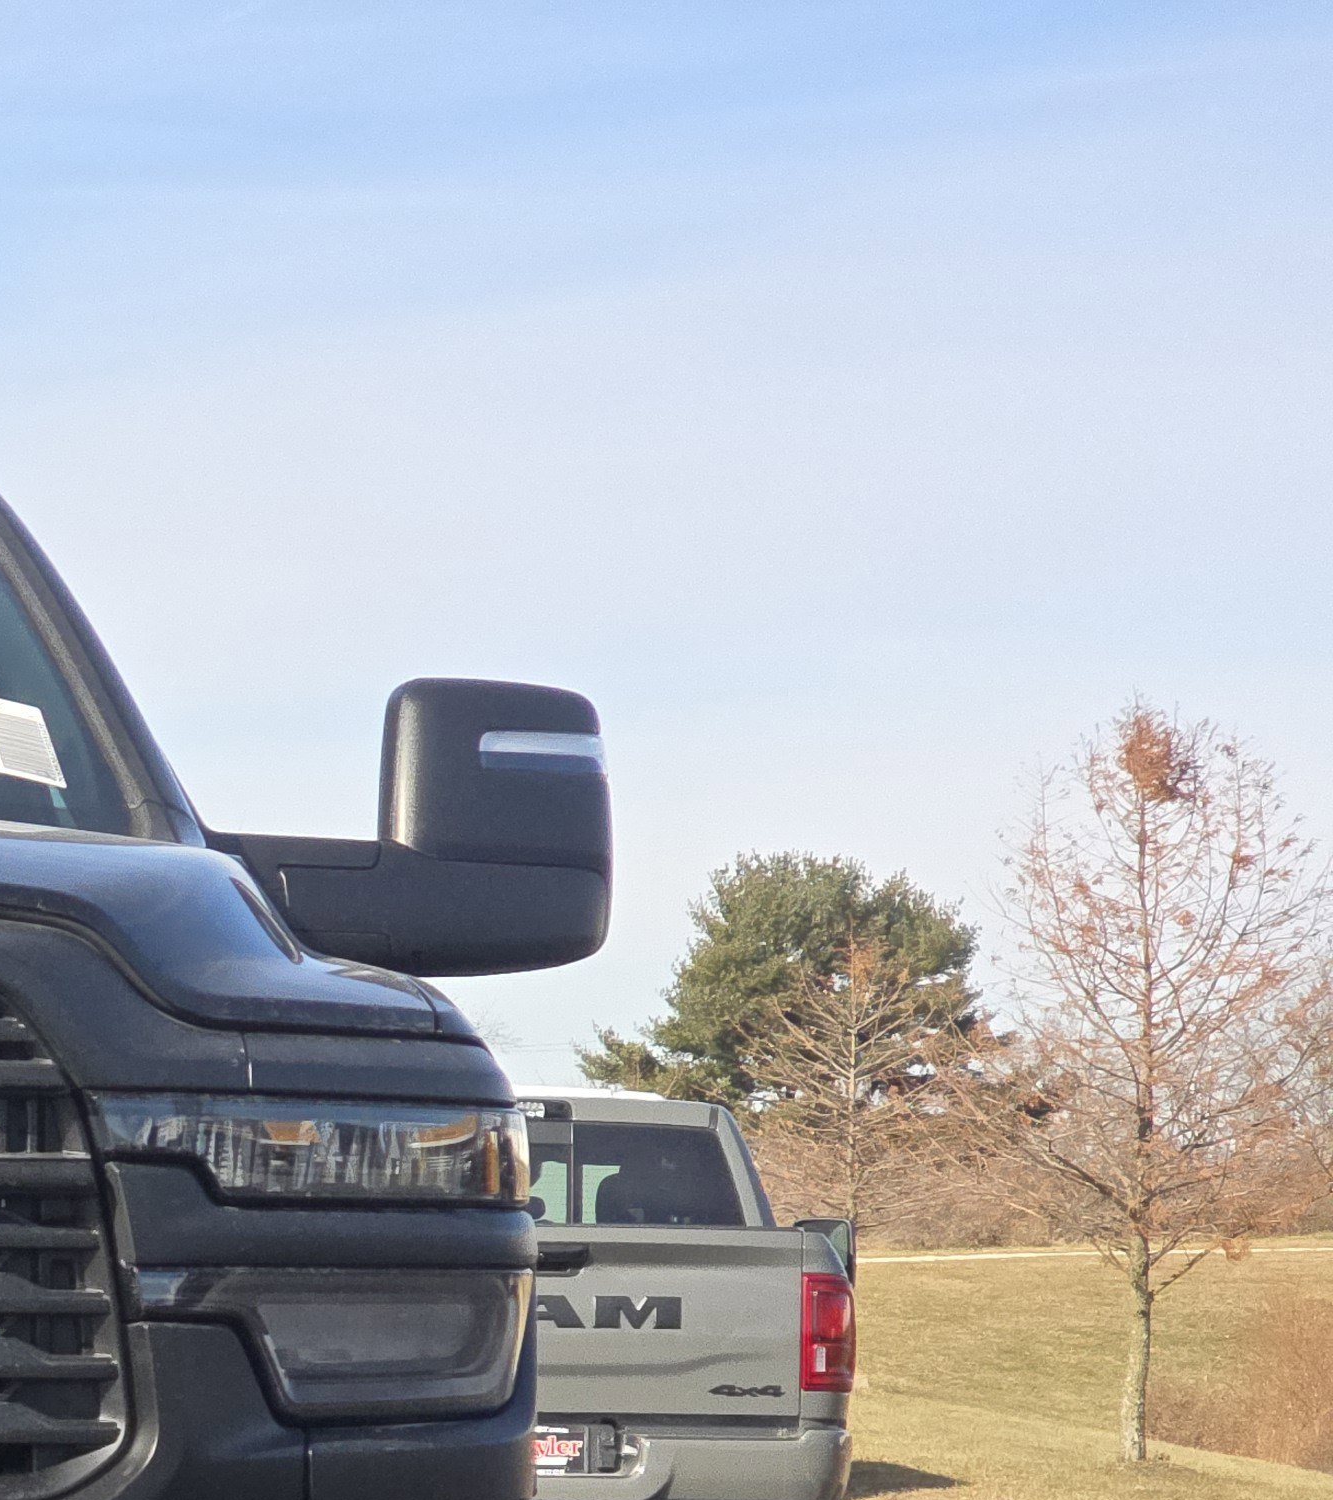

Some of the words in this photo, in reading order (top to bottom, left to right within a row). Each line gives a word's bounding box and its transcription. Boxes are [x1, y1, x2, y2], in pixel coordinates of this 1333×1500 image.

[537, 1295, 682, 1329] AM
[708, 1384, 785, 1397] 4x4
[534, 1435, 583, 1459] yler
